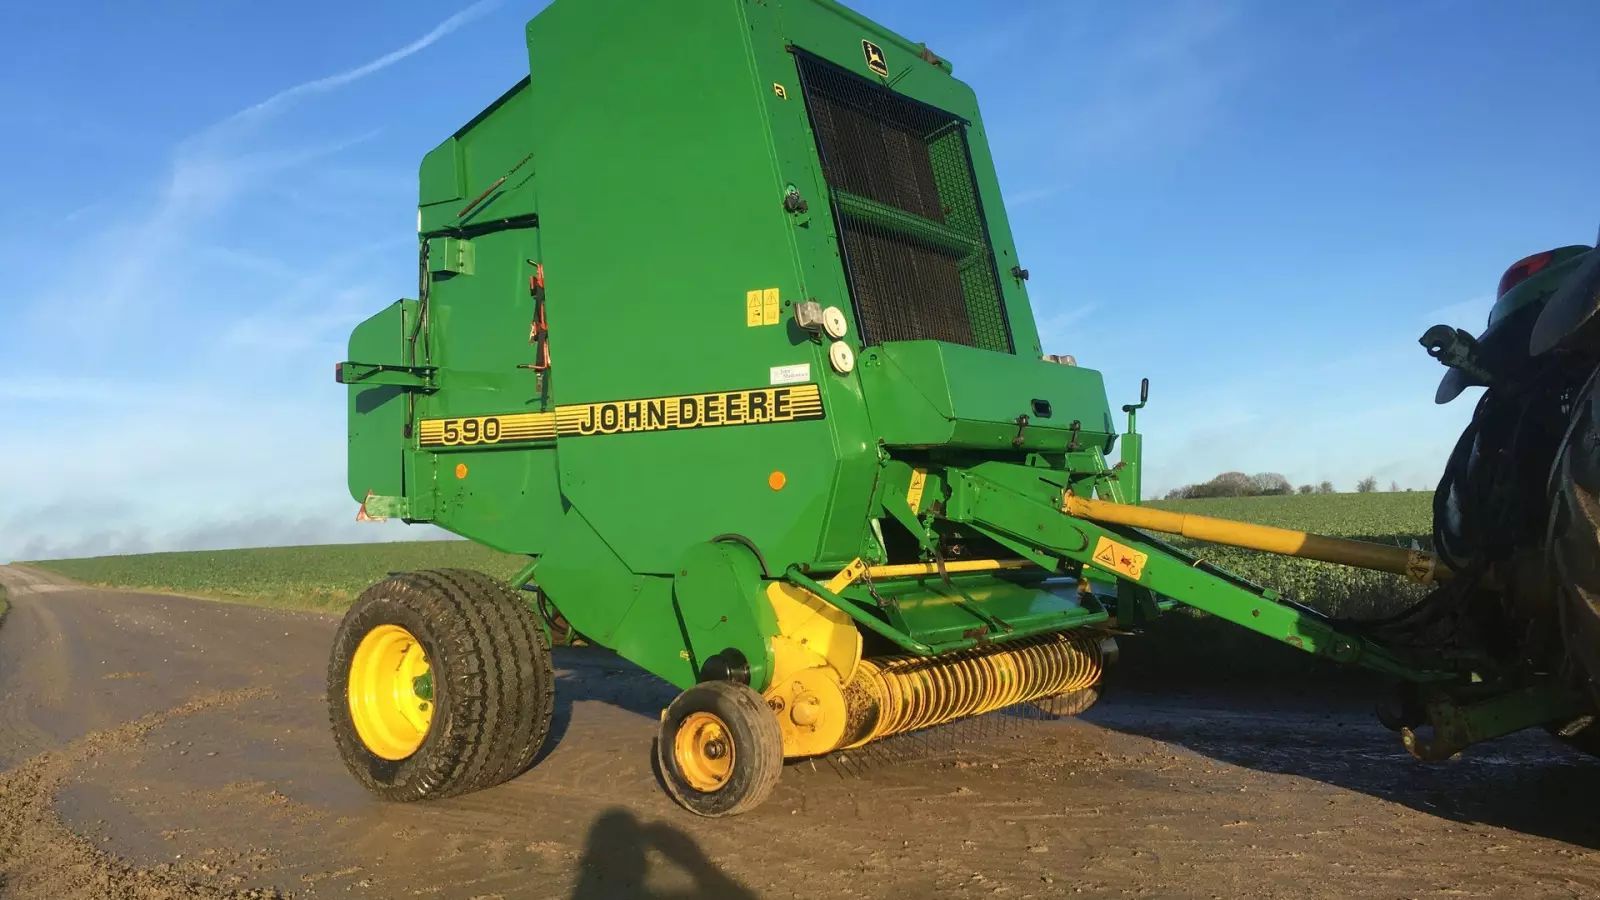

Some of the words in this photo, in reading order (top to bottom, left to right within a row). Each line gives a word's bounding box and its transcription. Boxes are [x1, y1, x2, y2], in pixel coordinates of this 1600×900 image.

[580, 399, 666, 433] JOHN
[679, 388, 791, 426] DEERE
[443, 417, 501, 444] 590
